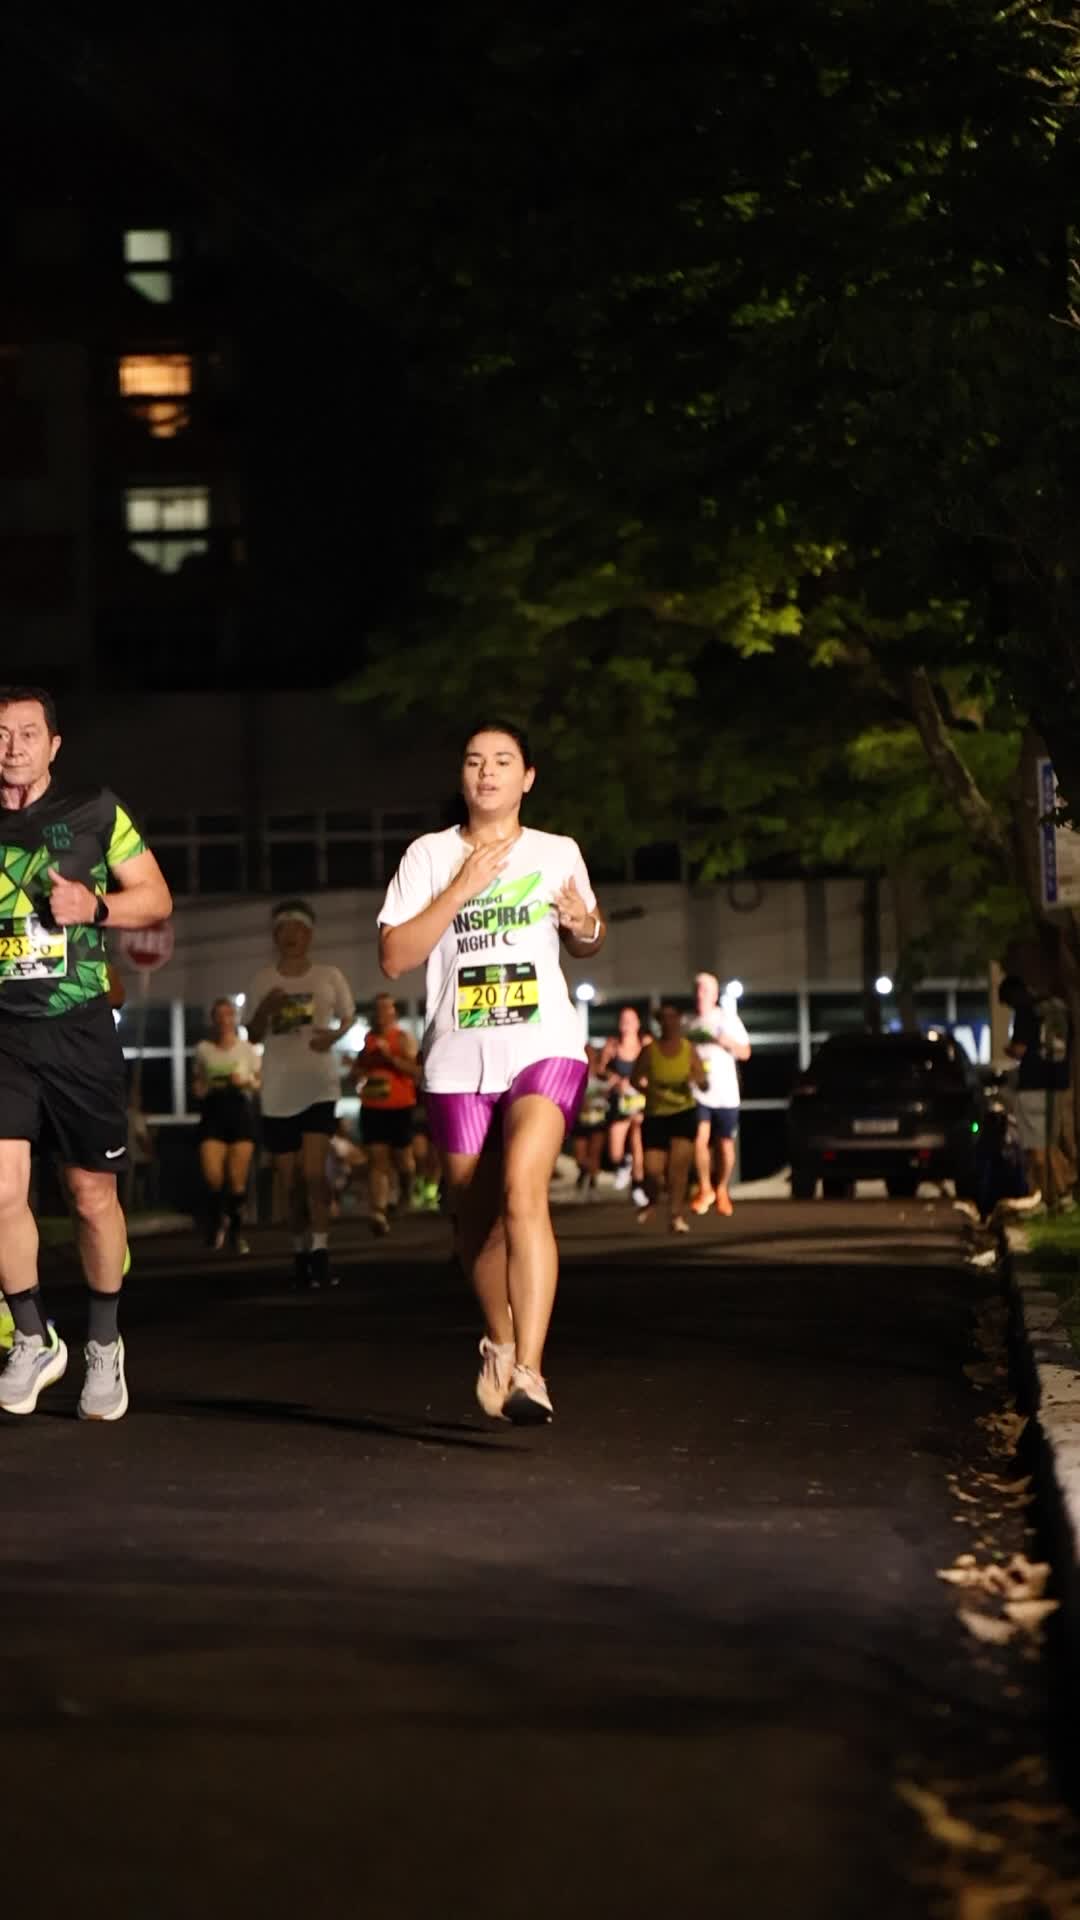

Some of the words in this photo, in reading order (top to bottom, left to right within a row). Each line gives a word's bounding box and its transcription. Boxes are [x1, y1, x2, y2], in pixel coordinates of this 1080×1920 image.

[453, 905, 531, 934] INSPIRA
[456, 933, 497, 955] NIGHT
[472, 983, 526, 1007] 2074
